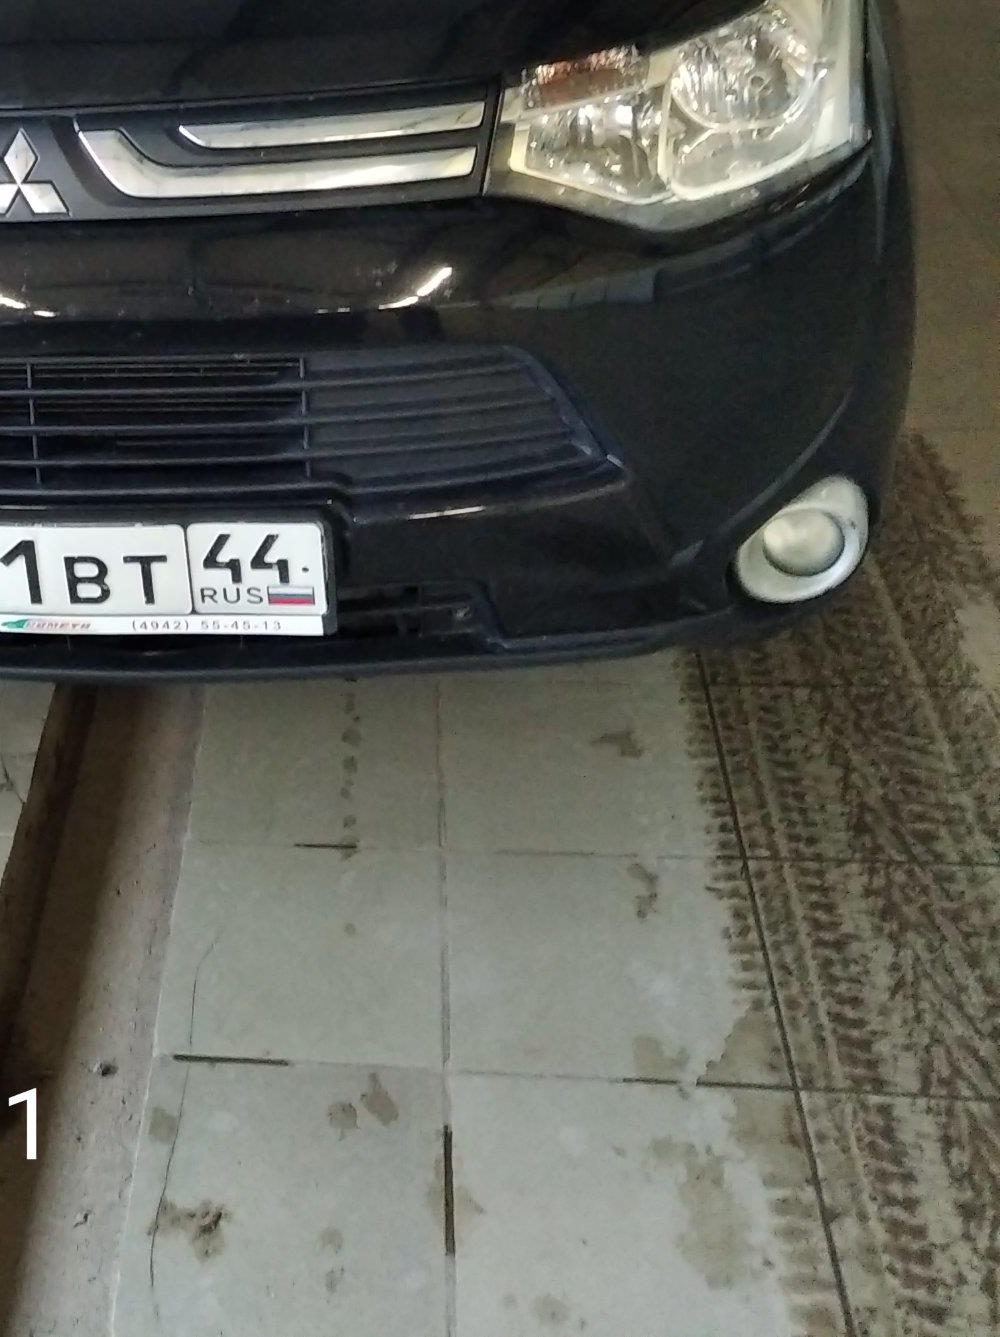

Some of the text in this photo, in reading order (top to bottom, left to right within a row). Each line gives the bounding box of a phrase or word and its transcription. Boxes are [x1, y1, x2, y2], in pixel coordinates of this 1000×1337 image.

[202, 533, 290, 584] 44
[200, 586, 264, 605] RUS
[131, 619, 282, 631] (4942) 55-45-13
